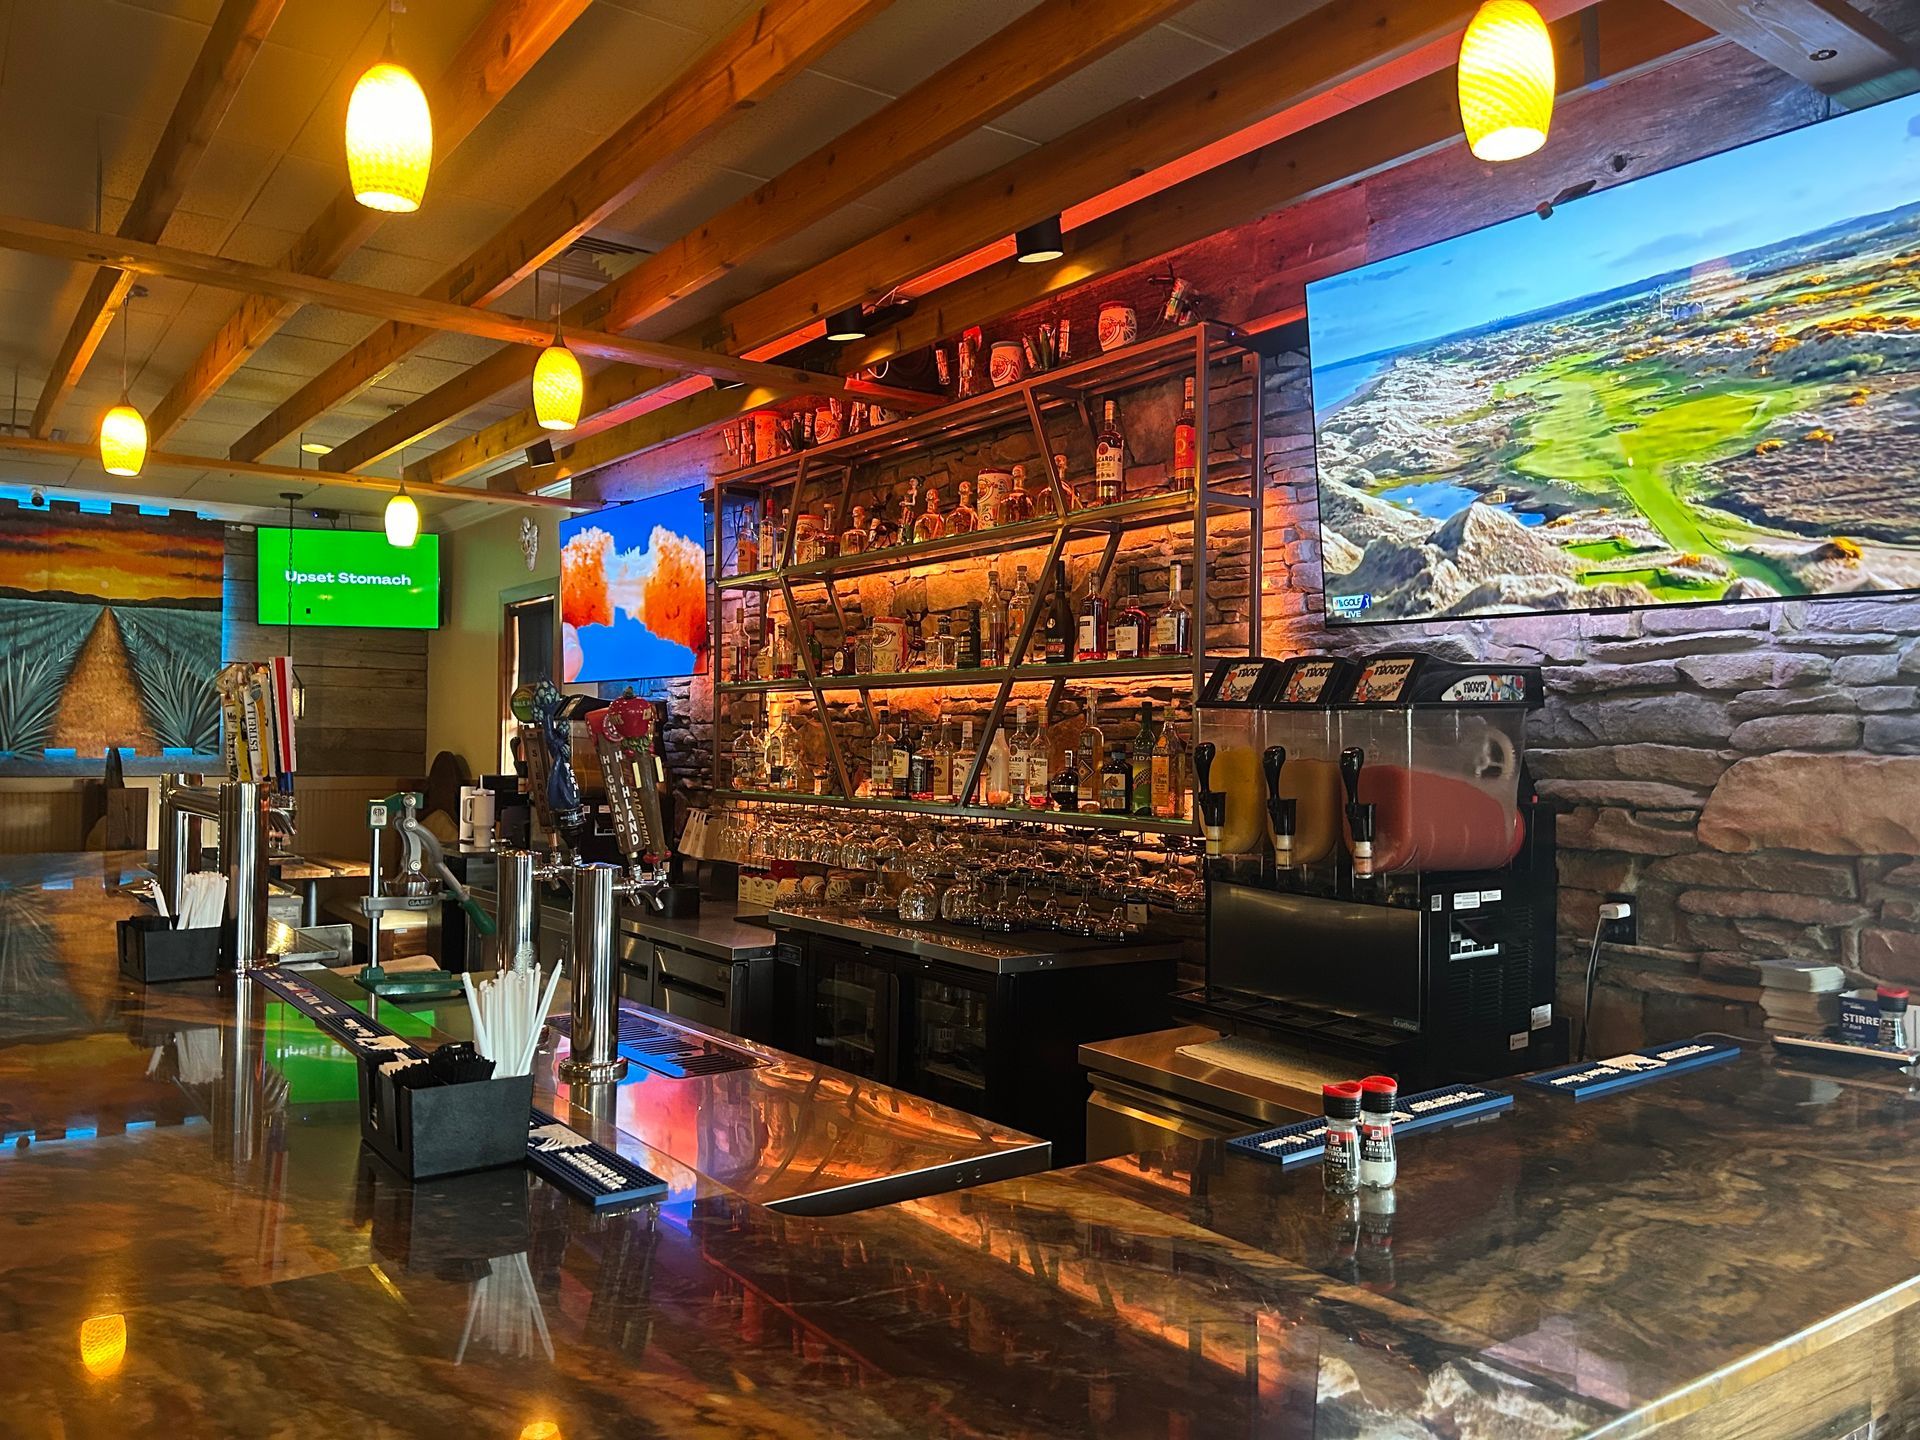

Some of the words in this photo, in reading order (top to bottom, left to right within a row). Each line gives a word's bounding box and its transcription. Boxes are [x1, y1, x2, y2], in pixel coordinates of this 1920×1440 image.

[285, 570, 335, 585] Upset
[338, 571, 412, 587] Stomach
[1344, 598, 1362, 607] GOLF
[1344, 610, 1362, 618] LIVE
[1374, 664, 1410, 676] FROSTY
[1463, 680, 1488, 694] FROSTY
[247, 701, 259, 752] ESTRELLA
[602, 755, 625, 833] HIGHLAND
[614, 750, 640, 846] HHLAND
[1842, 1013, 1882, 1027] STIRRE
[1365, 1139, 1376, 1147] SEA
